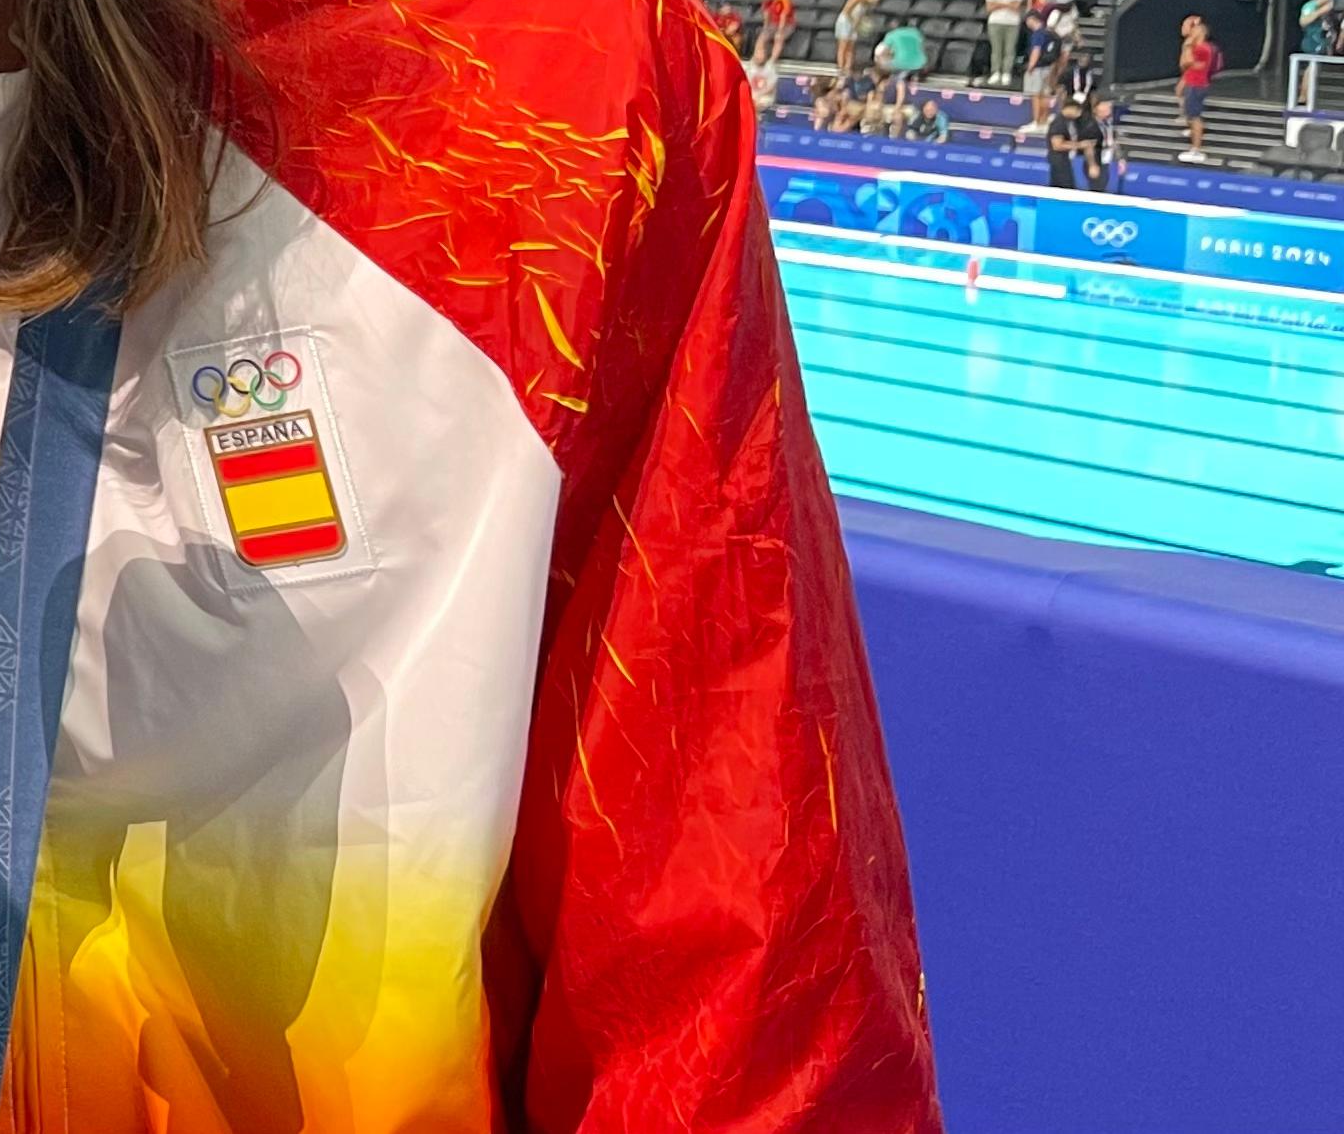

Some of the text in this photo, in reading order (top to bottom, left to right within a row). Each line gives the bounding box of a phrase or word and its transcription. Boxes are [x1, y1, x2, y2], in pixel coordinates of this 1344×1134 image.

[1200, 236, 1331, 266] PARIS 2024
[217, 419, 308, 451] ESPAÑA
